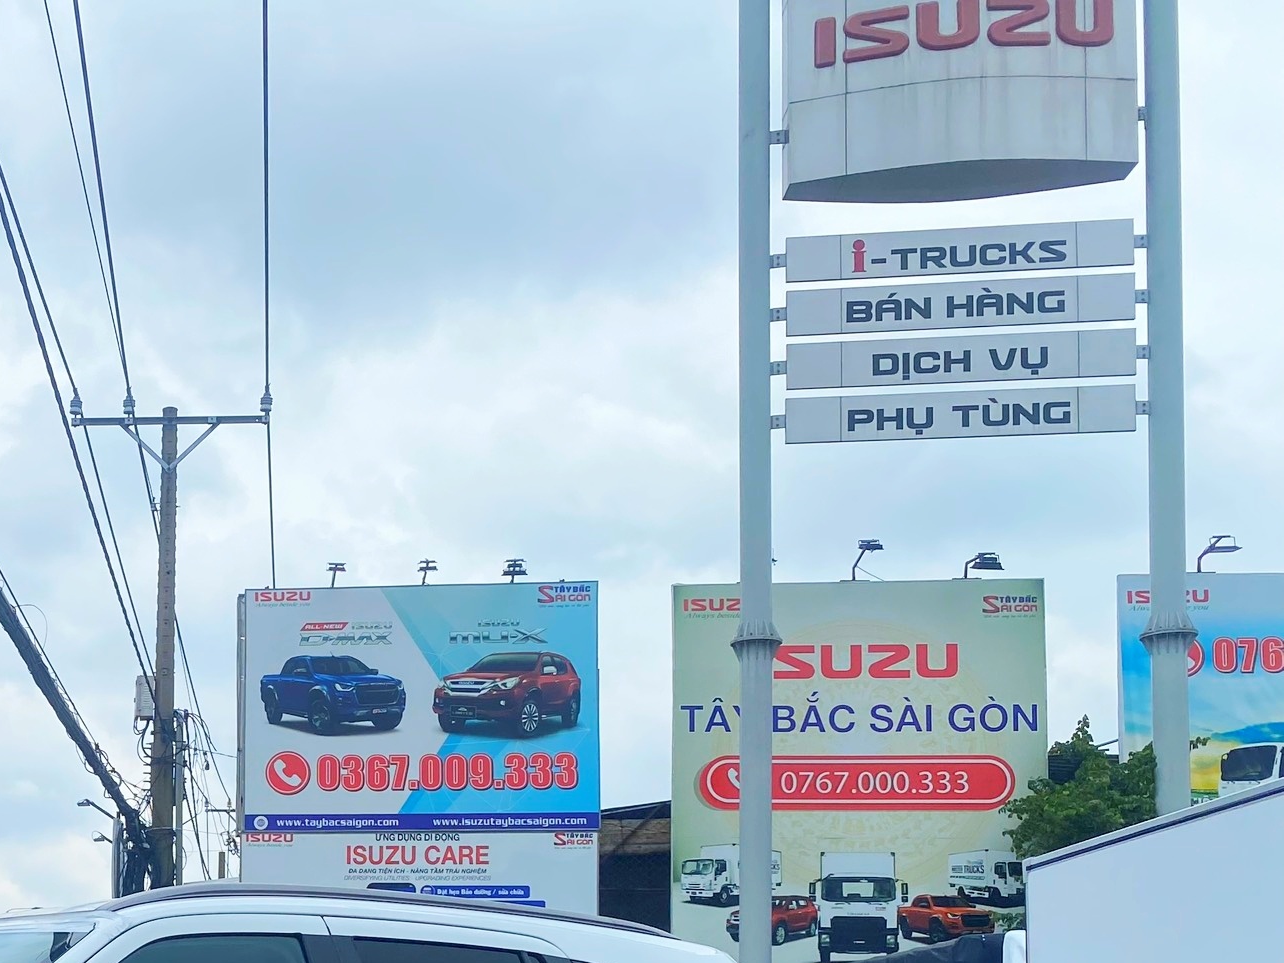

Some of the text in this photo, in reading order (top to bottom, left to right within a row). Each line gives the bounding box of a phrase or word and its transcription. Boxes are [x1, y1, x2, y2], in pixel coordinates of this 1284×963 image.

[814, 0, 1113, 68] ISUZU
[851, 239, 1067, 273] i-TRUCKS
[846, 287, 1066, 323] BÁN HÀNG
[872, 347, 1048, 380] DỊCH VỤ
[847, 398, 1071, 435] PHỤ TÙNG
[254, 591, 311, 602] ISUZU
[683, 598, 740, 611] ISUZ
[1127, 589, 1210, 604] ISU
[477, 619, 520, 627] ISUZU
[773, 644, 959, 679] SUZU
[772, 691, 855, 733] BẮC
[870, 696, 932, 733] SÀI
[948, 696, 1038, 733] GÒN
[316, 752, 579, 792] 0367.009.333
[780, 771, 970, 795] 0767.000.333
[276, 816, 587, 829] www.taybacsaigon.com www.isuzutaybacsaigon.com
[246, 833, 293, 842] ISUZU
[424, 833, 433, 841] DI
[346, 845, 490, 865] ISUZU CARE
